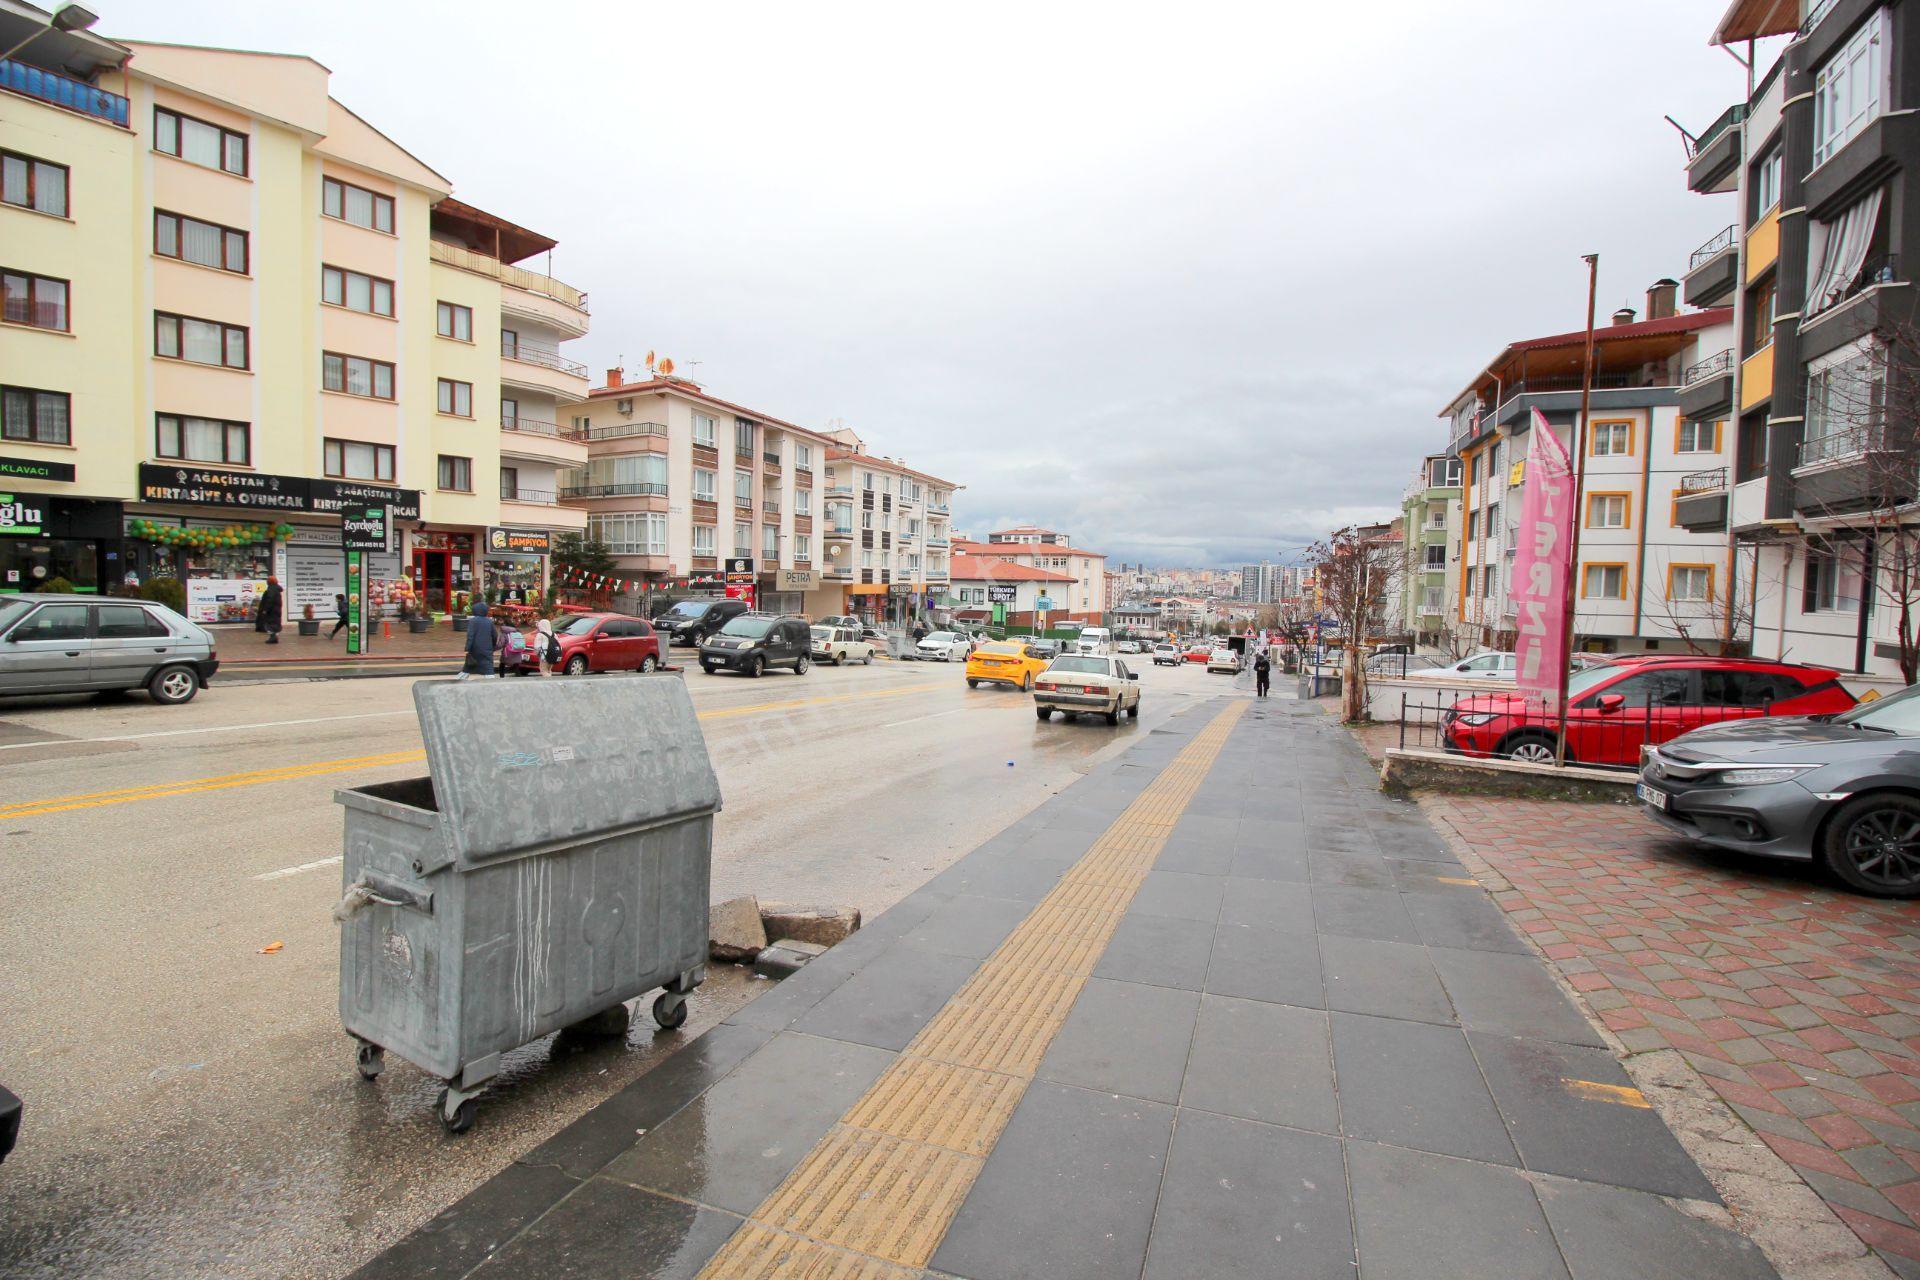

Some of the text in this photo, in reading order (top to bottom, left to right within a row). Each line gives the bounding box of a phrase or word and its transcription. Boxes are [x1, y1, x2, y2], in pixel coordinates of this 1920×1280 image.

[0, 463, 49, 476] KLAVACI
[192, 472, 265, 487] AĞAÇİSTAN
[146, 485, 304, 508] KIRTASİYE & OYUNCAK
[344, 487, 392, 499] AĞAÇİSTAN
[344, 519, 384, 532] Zeyrekoğlu
[786, 571, 811, 583] PETRA
[992, 593, 1011, 601] SPOT
